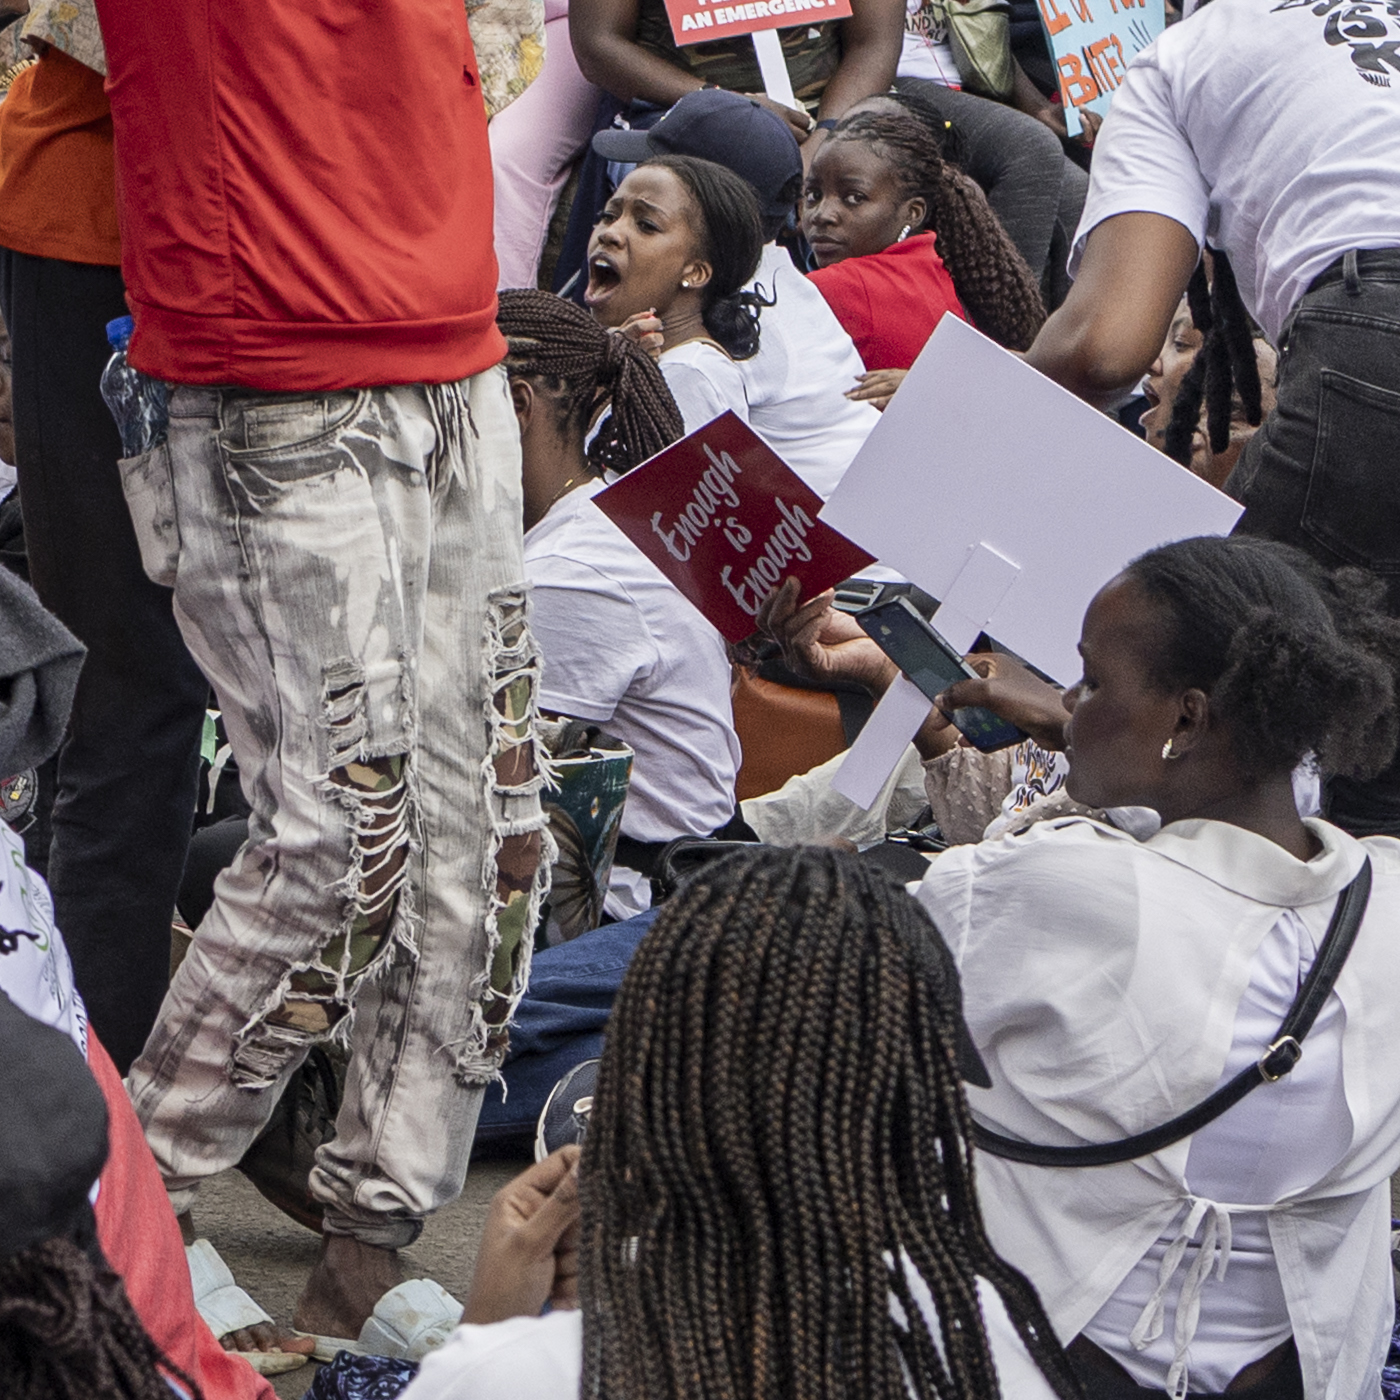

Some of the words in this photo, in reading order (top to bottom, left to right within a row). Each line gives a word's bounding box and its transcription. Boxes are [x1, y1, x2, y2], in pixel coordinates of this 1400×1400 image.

[681, 10, 714, 32] AN
[649, 441, 744, 564] Enough
[713, 515, 753, 553] is
[719, 495, 816, 617] Enough
